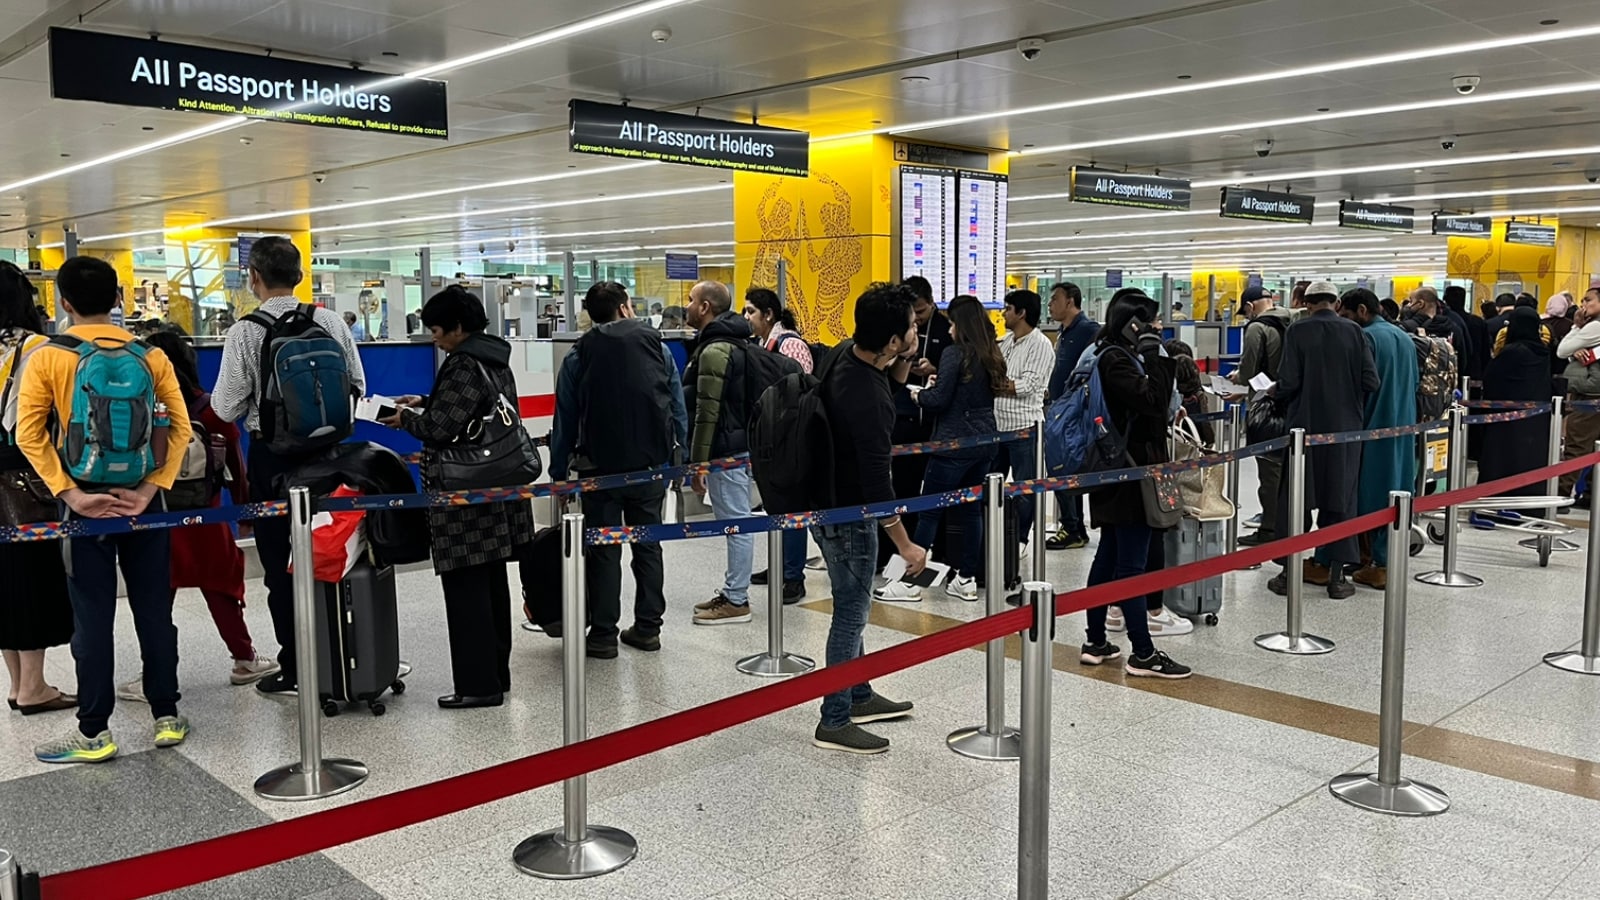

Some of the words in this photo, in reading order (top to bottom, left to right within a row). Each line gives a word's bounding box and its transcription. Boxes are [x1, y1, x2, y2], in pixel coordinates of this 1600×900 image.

[131, 56, 170, 87] All
[179, 62, 295, 102] Passport
[302, 79, 392, 113] Holders
[178, 98, 198, 109] Kind
[276, 109, 293, 119] with
[366, 119, 391, 130] Refusal
[391, 122, 399, 131] to
[400, 123, 423, 134] provide
[424, 126, 447, 136] correct
[619, 120, 643, 143] All
[647, 123, 716, 152] Passport
[720, 134, 775, 158] Holders
[1095, 178, 1107, 192] All
[1109, 179, 1143, 198] Passport
[1144, 183, 1173, 200] Holders
[1241, 197, 1251, 209] All
[1251, 198, 1278, 213] Passport
[1278, 201, 1301, 214] Holders
